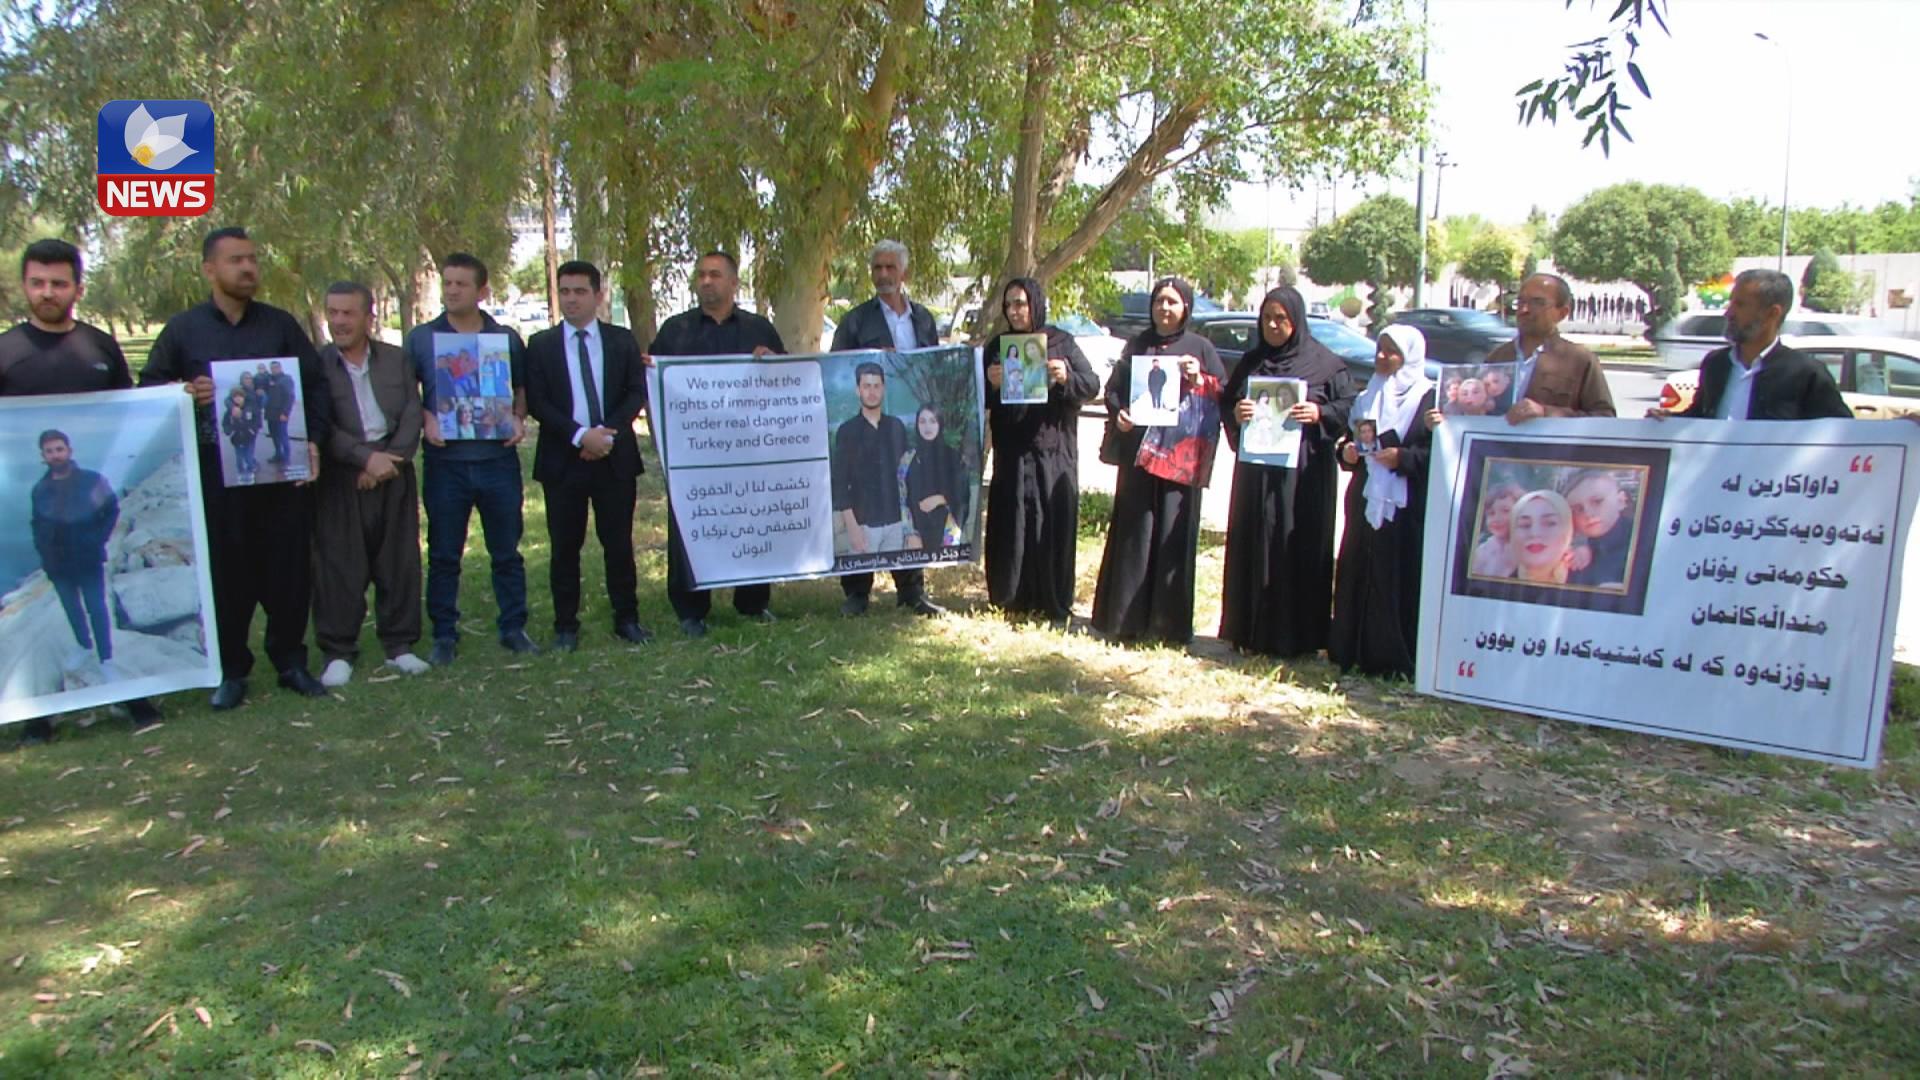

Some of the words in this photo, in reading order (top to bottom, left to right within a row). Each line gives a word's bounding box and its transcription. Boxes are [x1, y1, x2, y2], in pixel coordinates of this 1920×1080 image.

[686, 377, 709, 390] We
[712, 376, 753, 389] reveal
[755, 376, 779, 388] that
[782, 374, 801, 386] the
[669, 399, 708, 414] rights
[711, 395, 725, 409] of
[728, 395, 799, 410] immigrants
[801, 394, 821, 404] are
[682, 418, 722, 430] under
[725, 416, 750, 428] real
[753, 414, 799, 429] danger
[801, 412, 813, 423] in
[687, 436, 733, 452] Turkey
[735, 435, 761, 448] and
[763, 433, 810, 446] Greece
